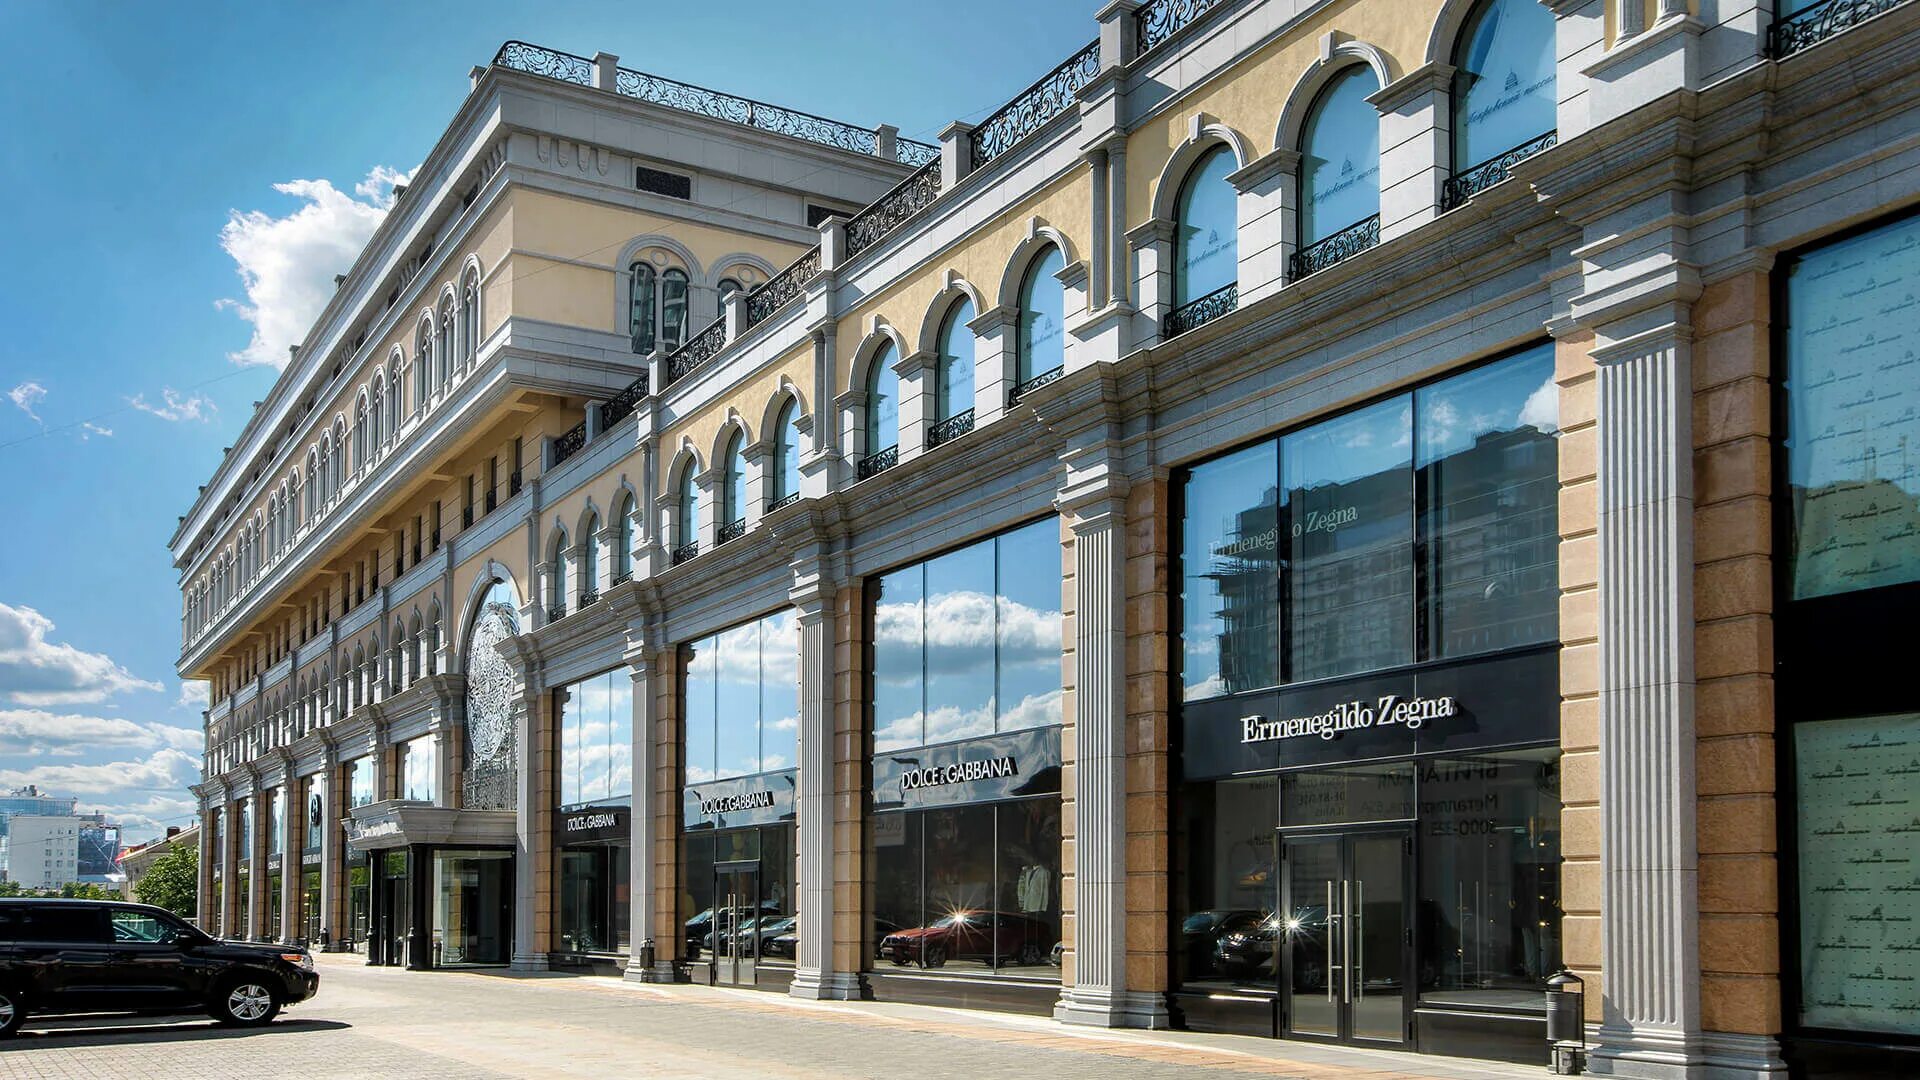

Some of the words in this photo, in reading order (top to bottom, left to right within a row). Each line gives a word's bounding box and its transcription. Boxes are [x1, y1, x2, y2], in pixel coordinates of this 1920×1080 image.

[1208, 524, 1302, 561] Ermenegio
[1306, 506, 1359, 533] Zegna
[1240, 701, 1373, 743] Ermenegildo
[1377, 694, 1453, 729] Zegna
